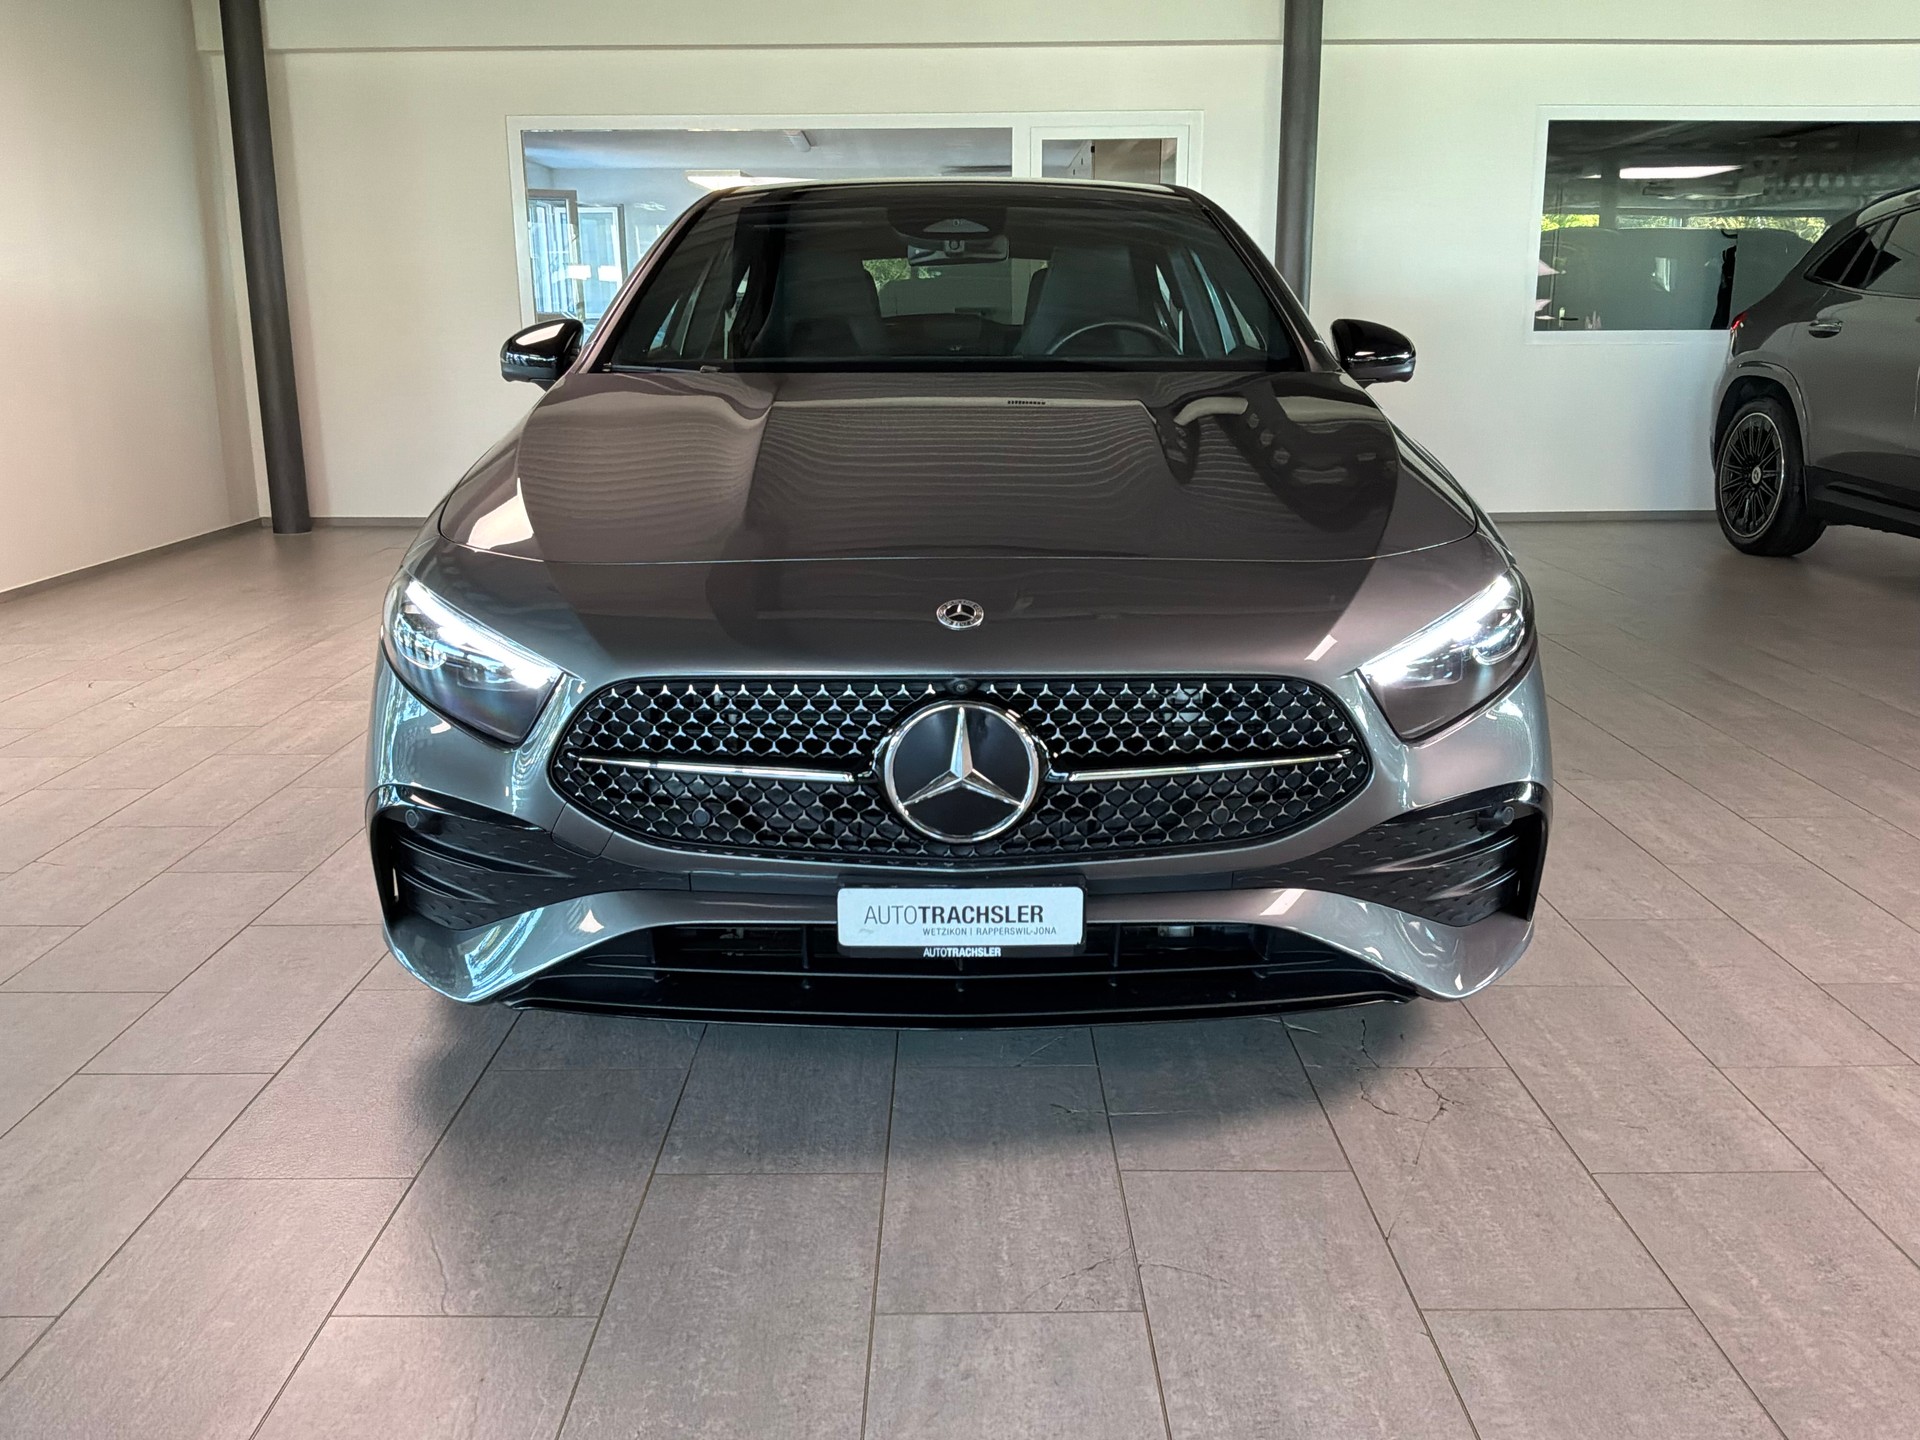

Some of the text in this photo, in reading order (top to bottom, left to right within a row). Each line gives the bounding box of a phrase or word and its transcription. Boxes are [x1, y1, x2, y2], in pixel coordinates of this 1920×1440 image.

[864, 905, 1043, 925] AUTOTRACHSLER
[923, 927, 1057, 936] WETZIKON RAPPERSWIL-JONA
[923, 948, 1001, 957] AUTOTRACHSLER
